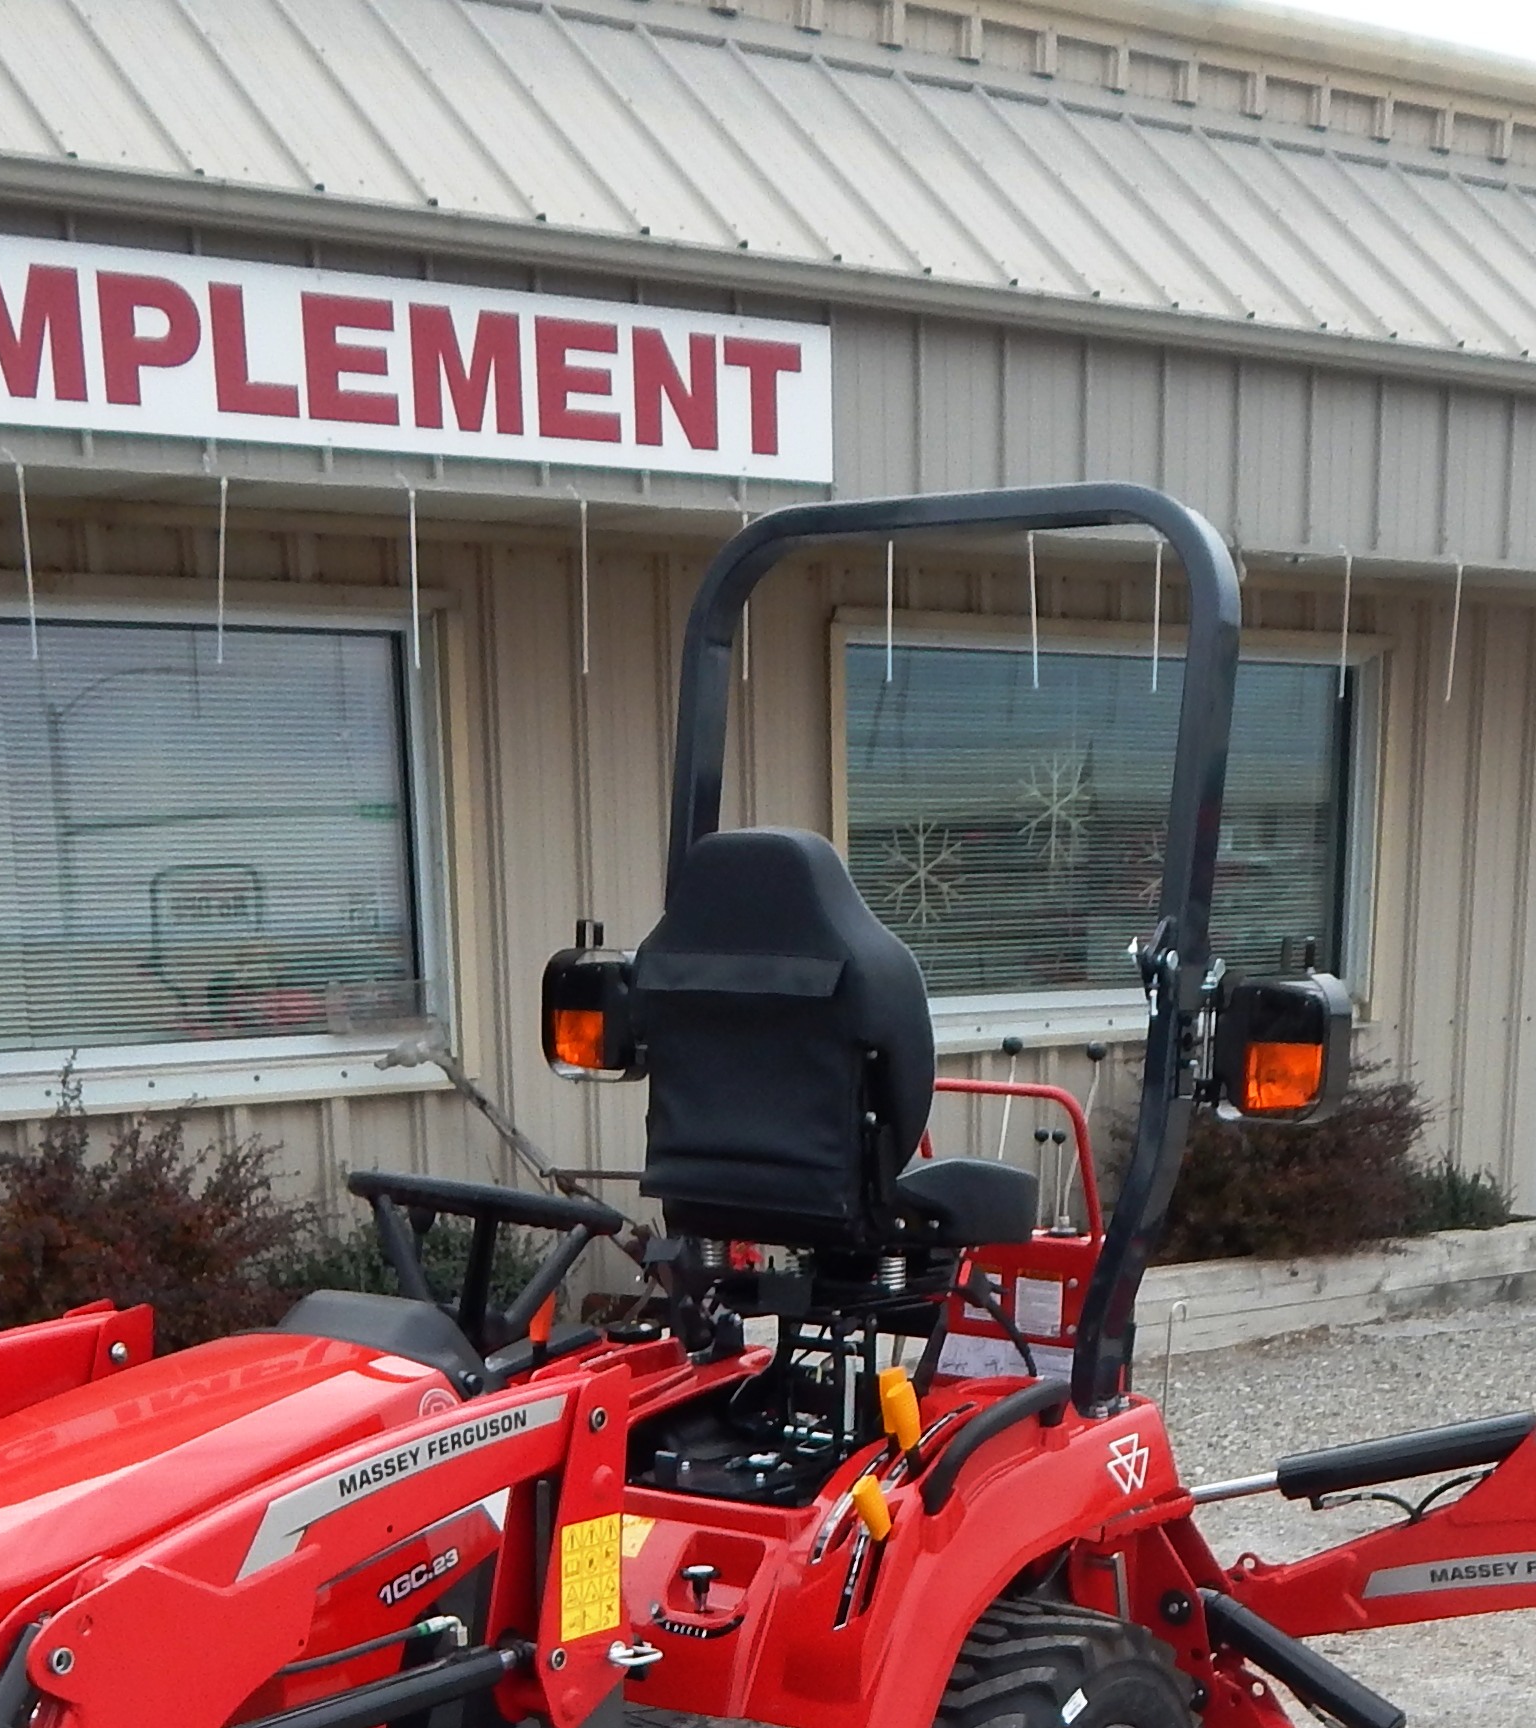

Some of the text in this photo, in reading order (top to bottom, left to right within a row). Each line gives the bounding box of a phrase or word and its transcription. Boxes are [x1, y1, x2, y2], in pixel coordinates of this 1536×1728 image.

[337, 1408, 528, 1498] MASSEY FERGUSON
[1429, 1561, 1518, 1583] MASSEY
